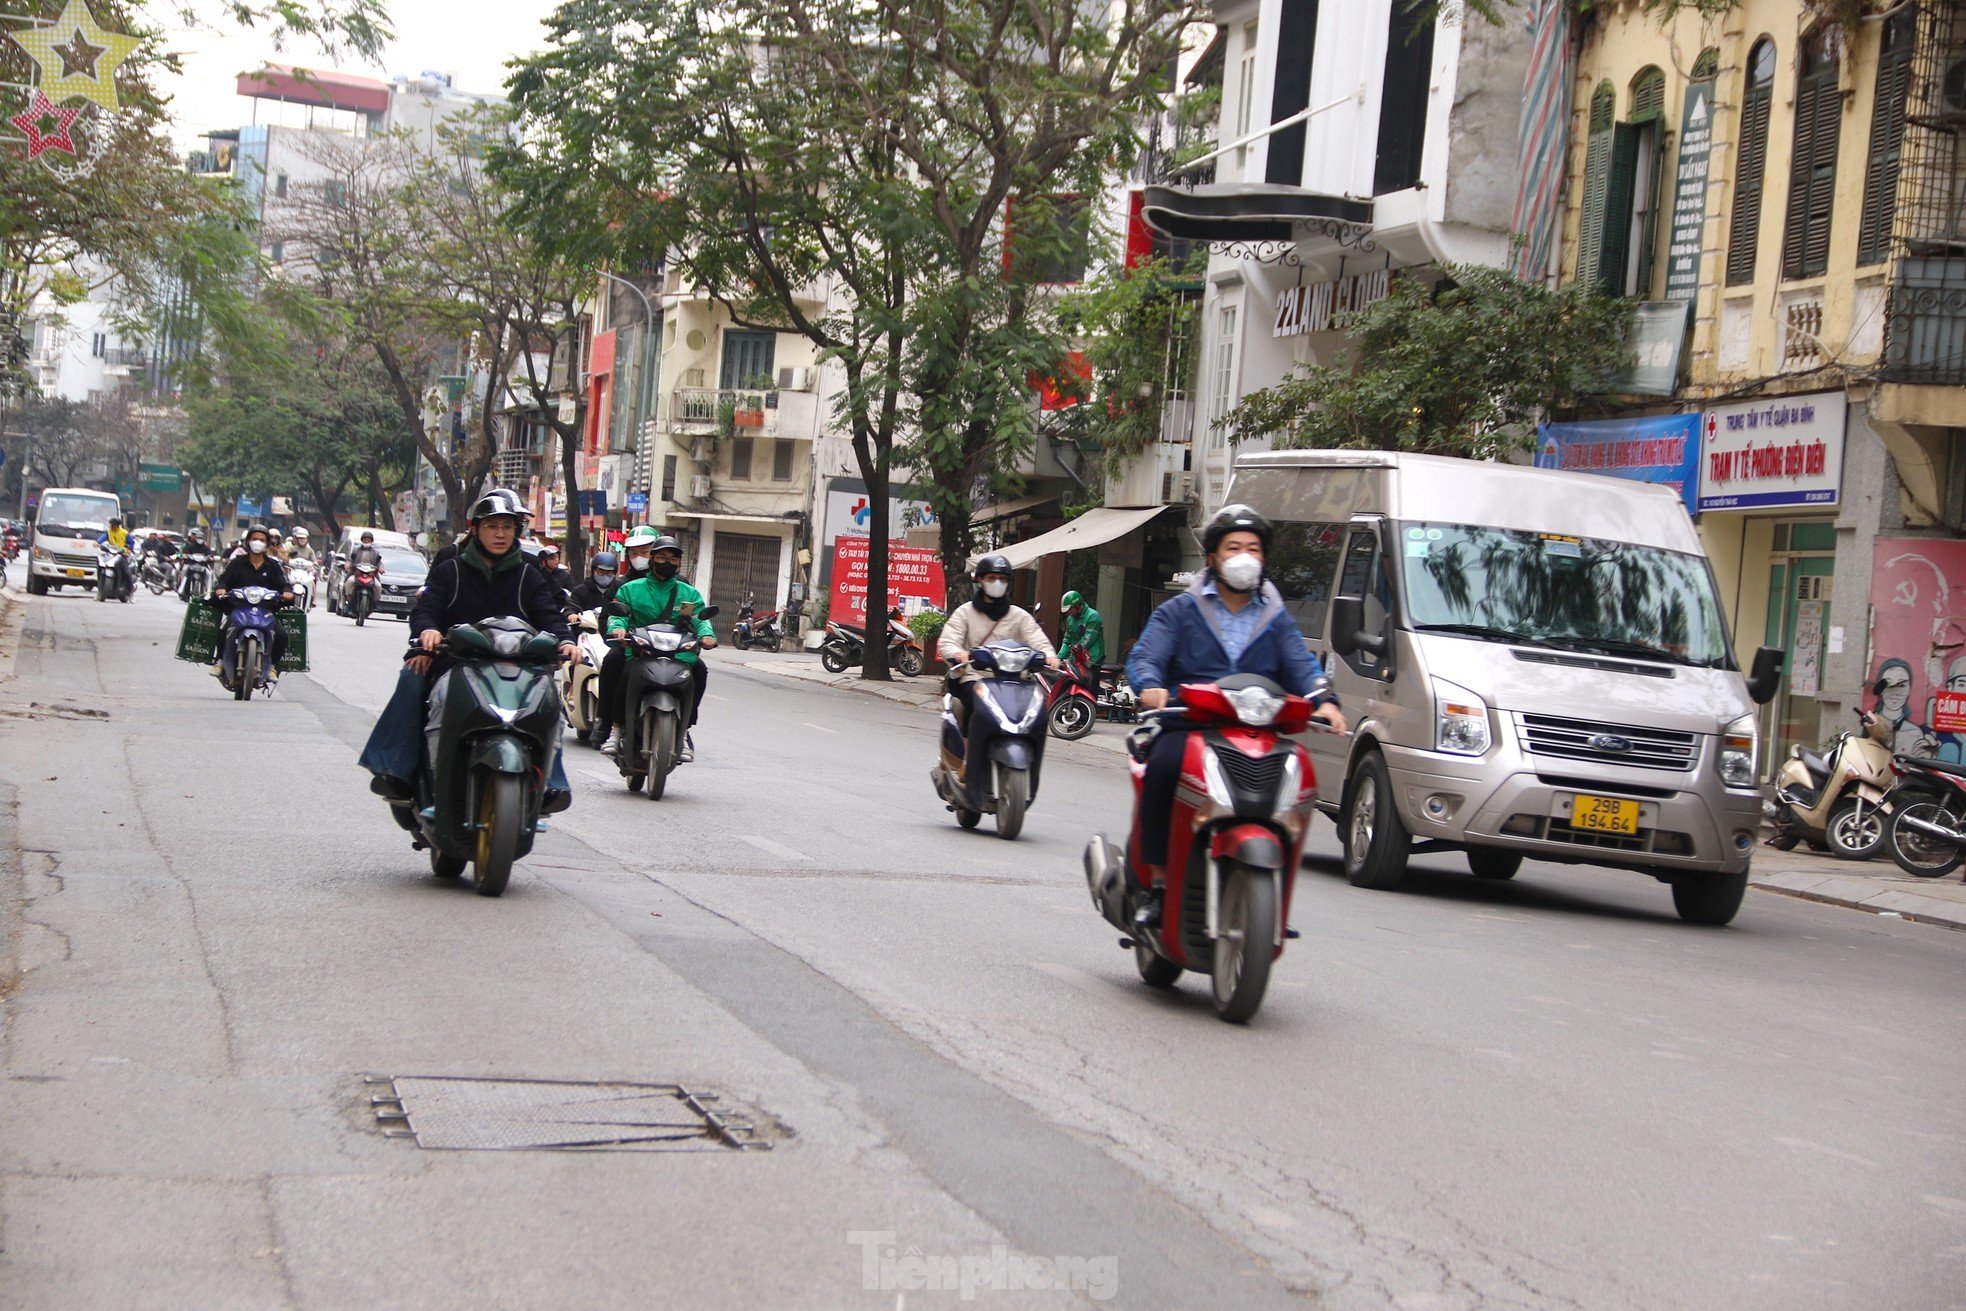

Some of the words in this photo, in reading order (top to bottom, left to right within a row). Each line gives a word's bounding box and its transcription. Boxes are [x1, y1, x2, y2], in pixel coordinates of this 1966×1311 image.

[1726, 413, 1745, 432] TRUNG
[1747, 408, 1759, 428] TÂM
[1710, 451, 1732, 487] TRẠM
[1734, 450, 1740, 479] Y
[1741, 440, 1753, 479] TẾ
[1751, 440, 1784, 479] PHƯỜNG
[1937, 694, 1959, 714] CẤM
[1599, 736, 1625, 749] Ford
[1592, 798, 1621, 815] 29B
[1580, 812, 1630, 832] 194.64
